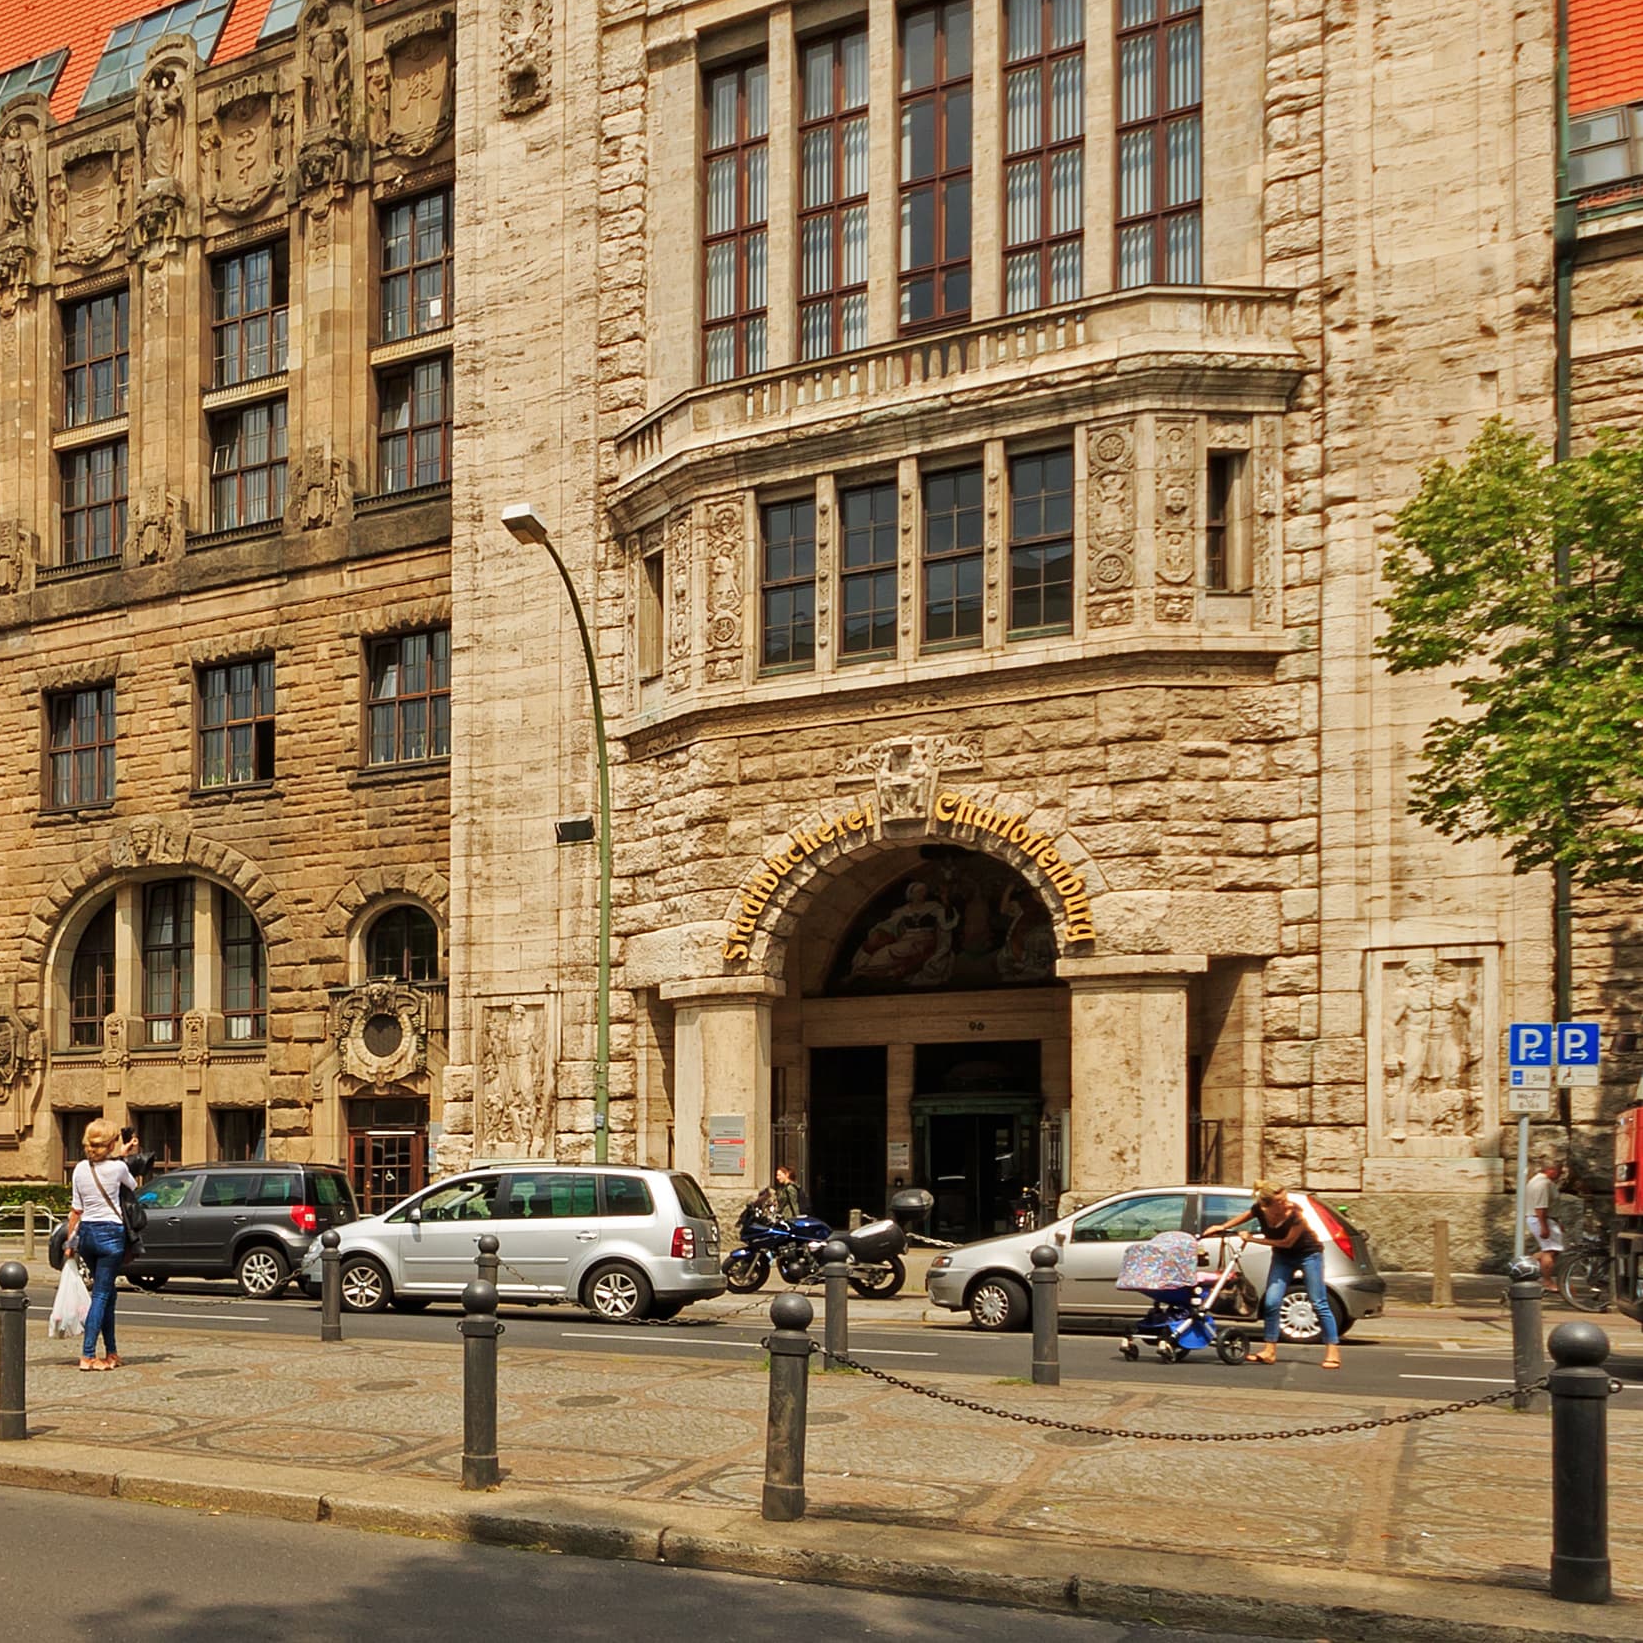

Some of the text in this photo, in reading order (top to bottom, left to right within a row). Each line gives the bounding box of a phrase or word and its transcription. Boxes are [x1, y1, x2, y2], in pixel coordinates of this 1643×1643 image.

[722, 791, 1096, 961] Stadtbücherei Charlottenburg
[1518, 1028, 1542, 1061] P
[1564, 1028, 1587, 1060] P
